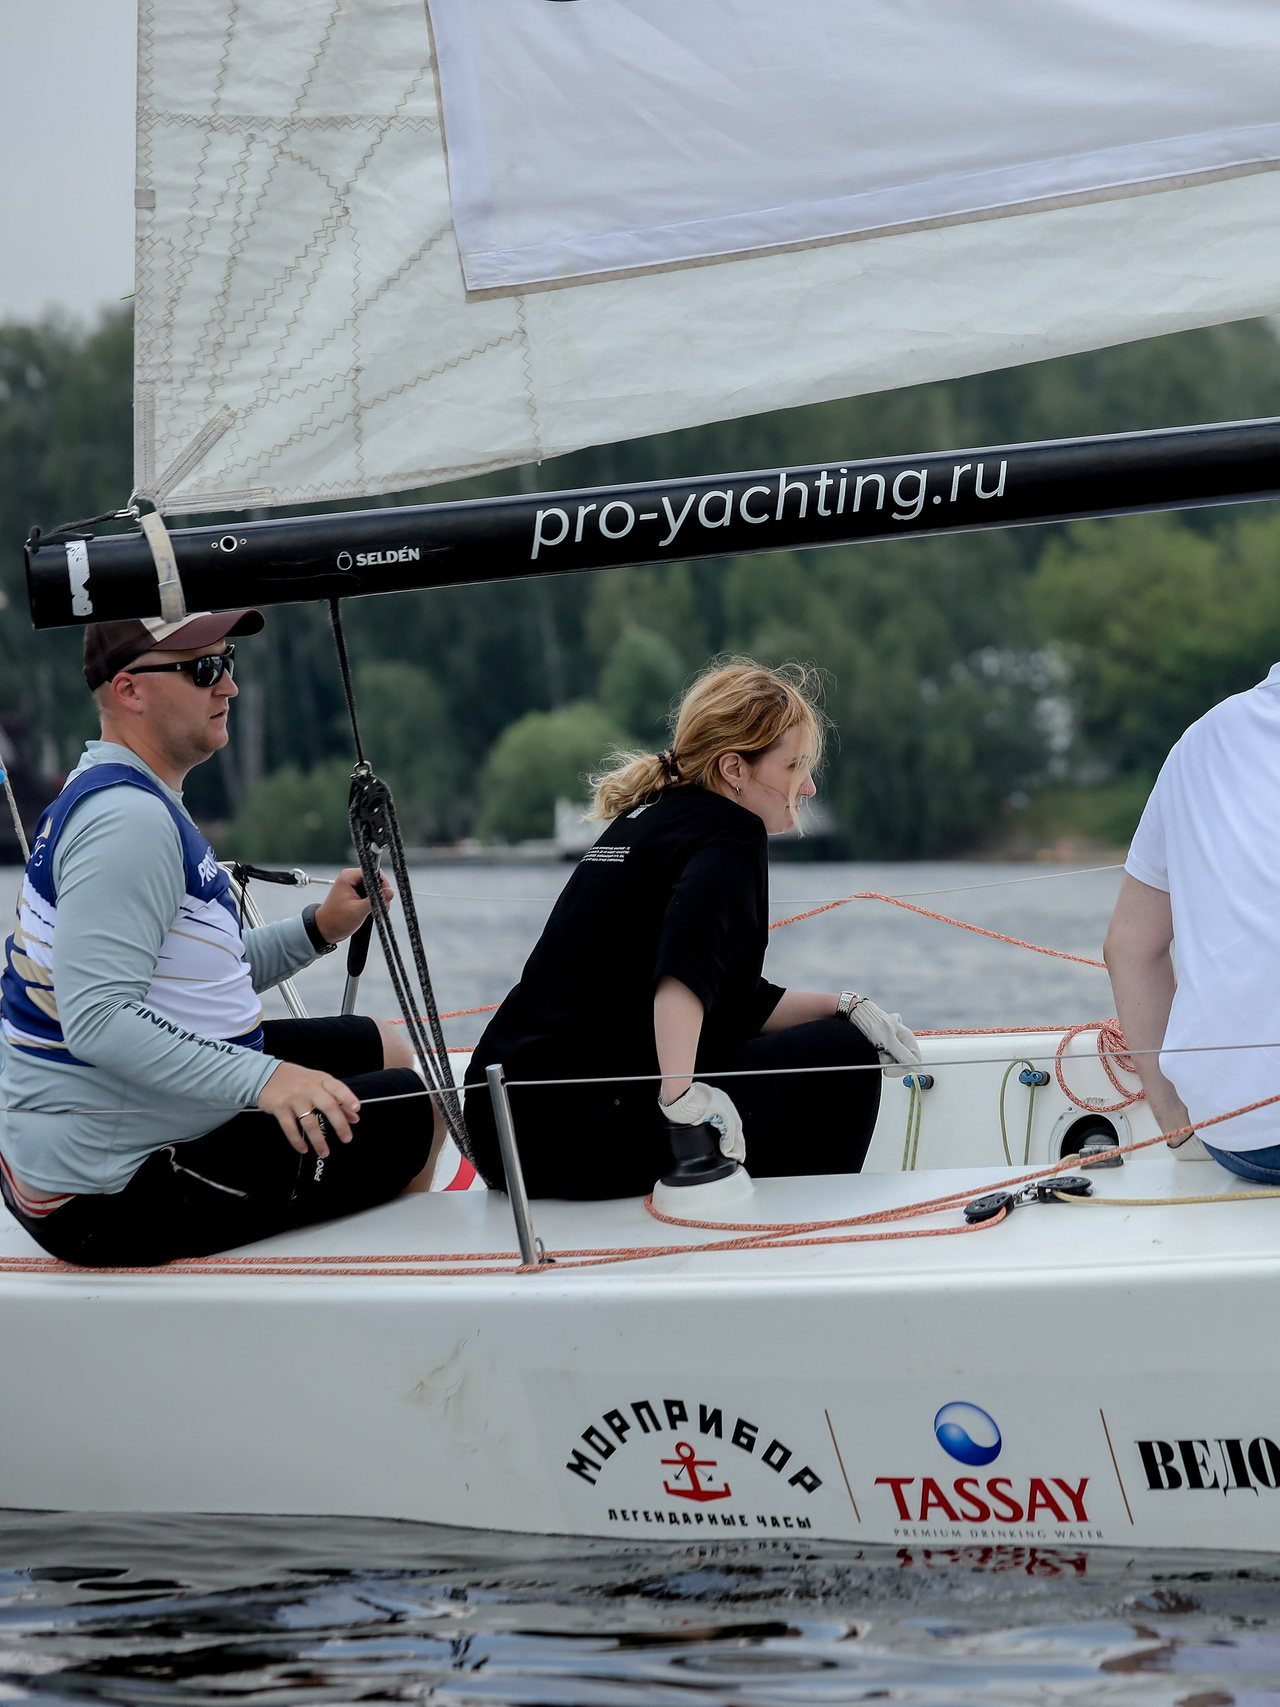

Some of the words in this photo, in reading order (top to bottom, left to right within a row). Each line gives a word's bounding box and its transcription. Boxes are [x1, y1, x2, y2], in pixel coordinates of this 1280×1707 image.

[530, 459, 1008, 559] pro-yachting.ru
[355, 545, 420, 567] SELDÉN
[565, 1398, 824, 1495] МОРПРИБОР
[874, 1476, 1091, 1524] TASSAY
[607, 1508, 749, 1527] ЛЕГЕНДАРНЫЕ
[756, 1514, 812, 1530] ЧАСЫ
[893, 1527, 962, 1539] PREMIUM
[969, 1528, 1047, 1540] DRINKING
[1054, 1530, 1105, 1540] WATER
